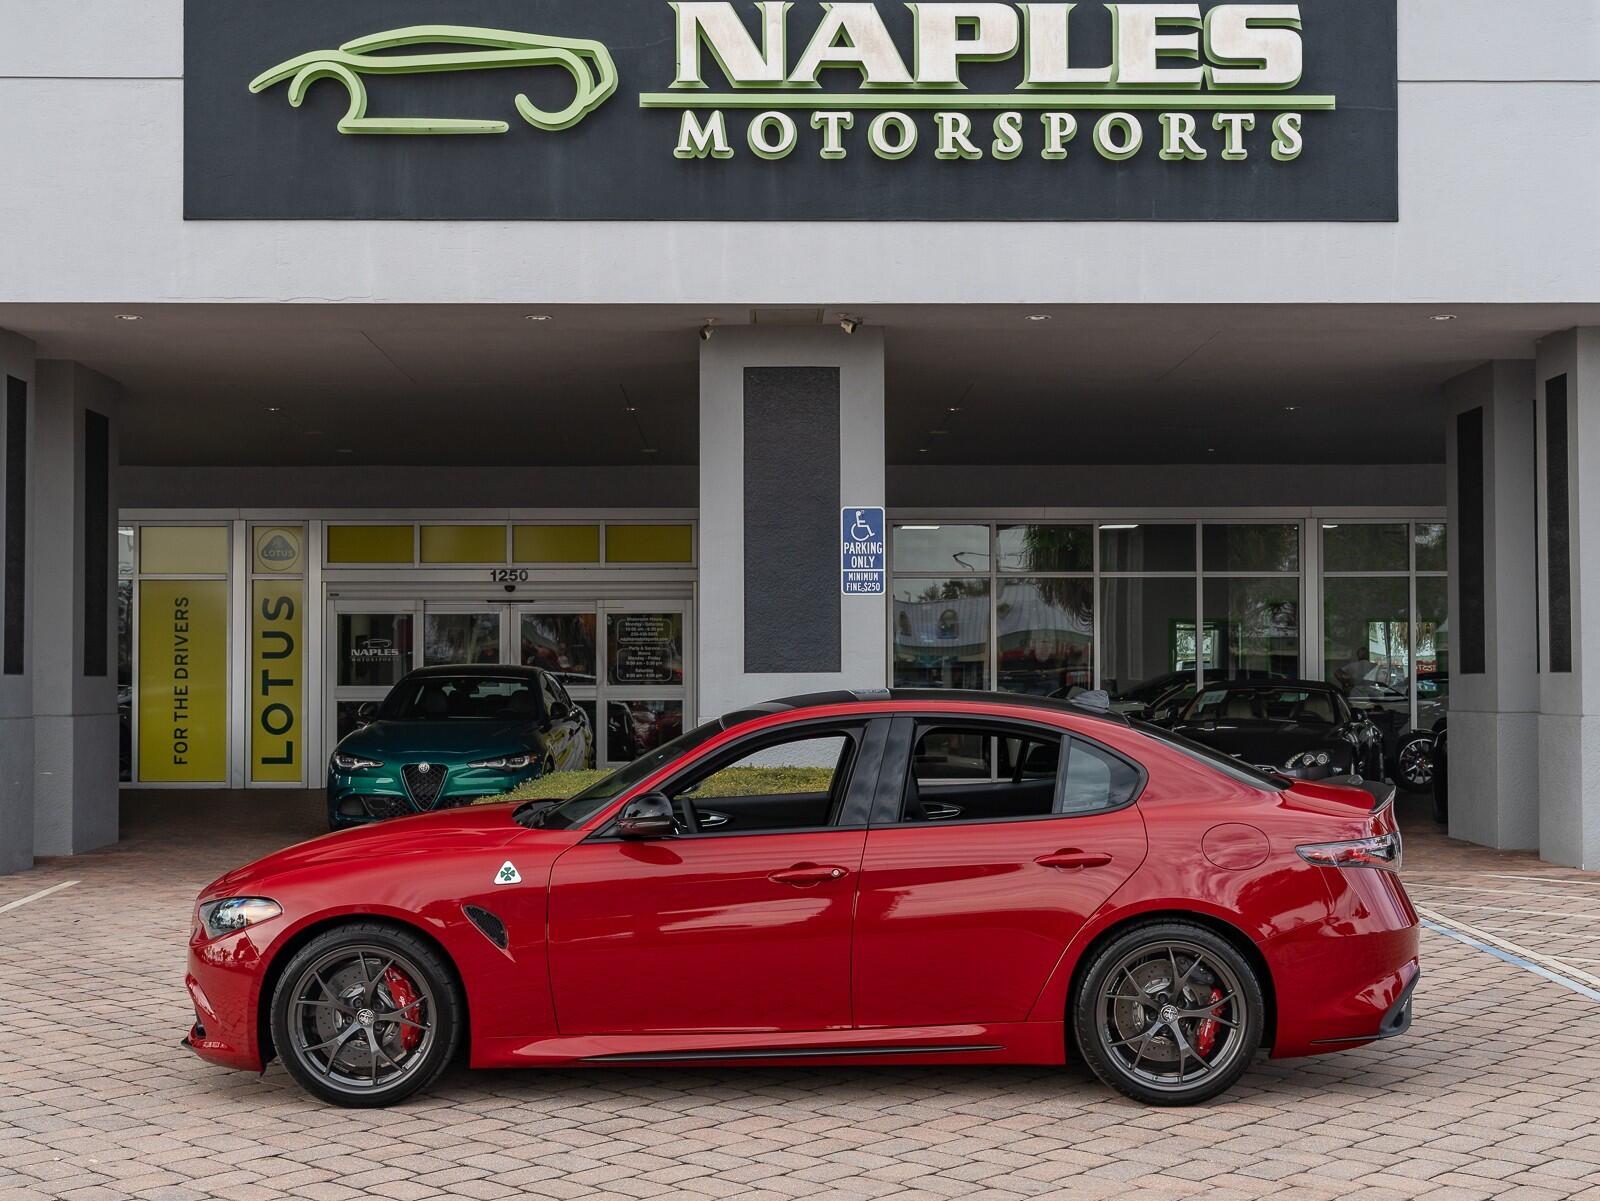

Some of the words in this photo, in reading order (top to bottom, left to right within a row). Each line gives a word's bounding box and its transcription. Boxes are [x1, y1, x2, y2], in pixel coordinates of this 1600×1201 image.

[669, 1, 1303, 90] NAPLES
[674, 110, 1302, 161] MOTORSPORTS
[844, 542, 883, 554] PARKING
[851, 556, 875, 568] ONLY
[490, 570, 529, 582] 1250
[846, 582, 862, 591] FINE
[864, 582, 880, 592] $250
[848, 572, 879, 581] MINIMUM
[174, 597, 189, 681] DRIVERS
[351, 648, 399, 656] NAPLES
[261, 596, 295, 765] LOTUS
[174, 685, 188, 722] THE
[174, 729, 188, 765] FOR
